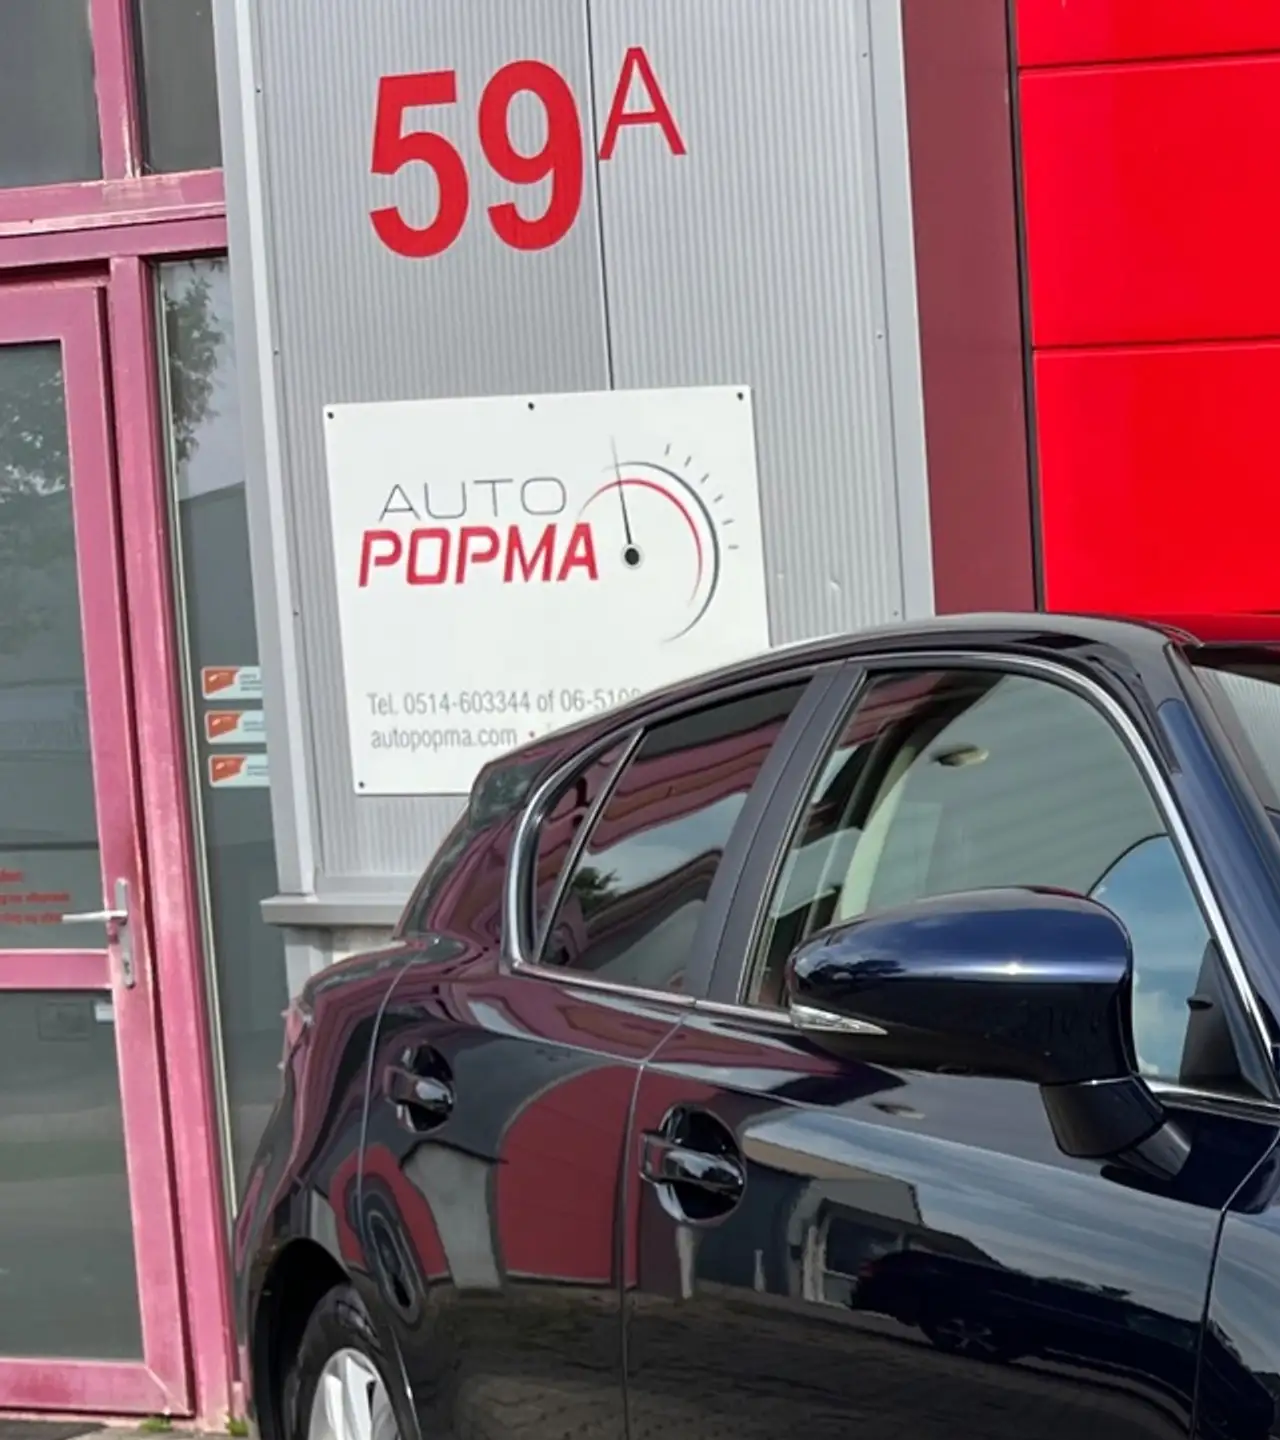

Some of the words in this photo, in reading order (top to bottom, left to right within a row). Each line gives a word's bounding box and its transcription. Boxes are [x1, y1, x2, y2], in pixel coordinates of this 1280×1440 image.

[378, 476, 567, 522] AUTO
[358, 522, 599, 588] POPMA
[366, 692, 398, 716] Tel.
[403, 689, 531, 715] 0514-603344
[537, 688, 555, 711] of
[370, 726, 518, 751] autopopma.com
